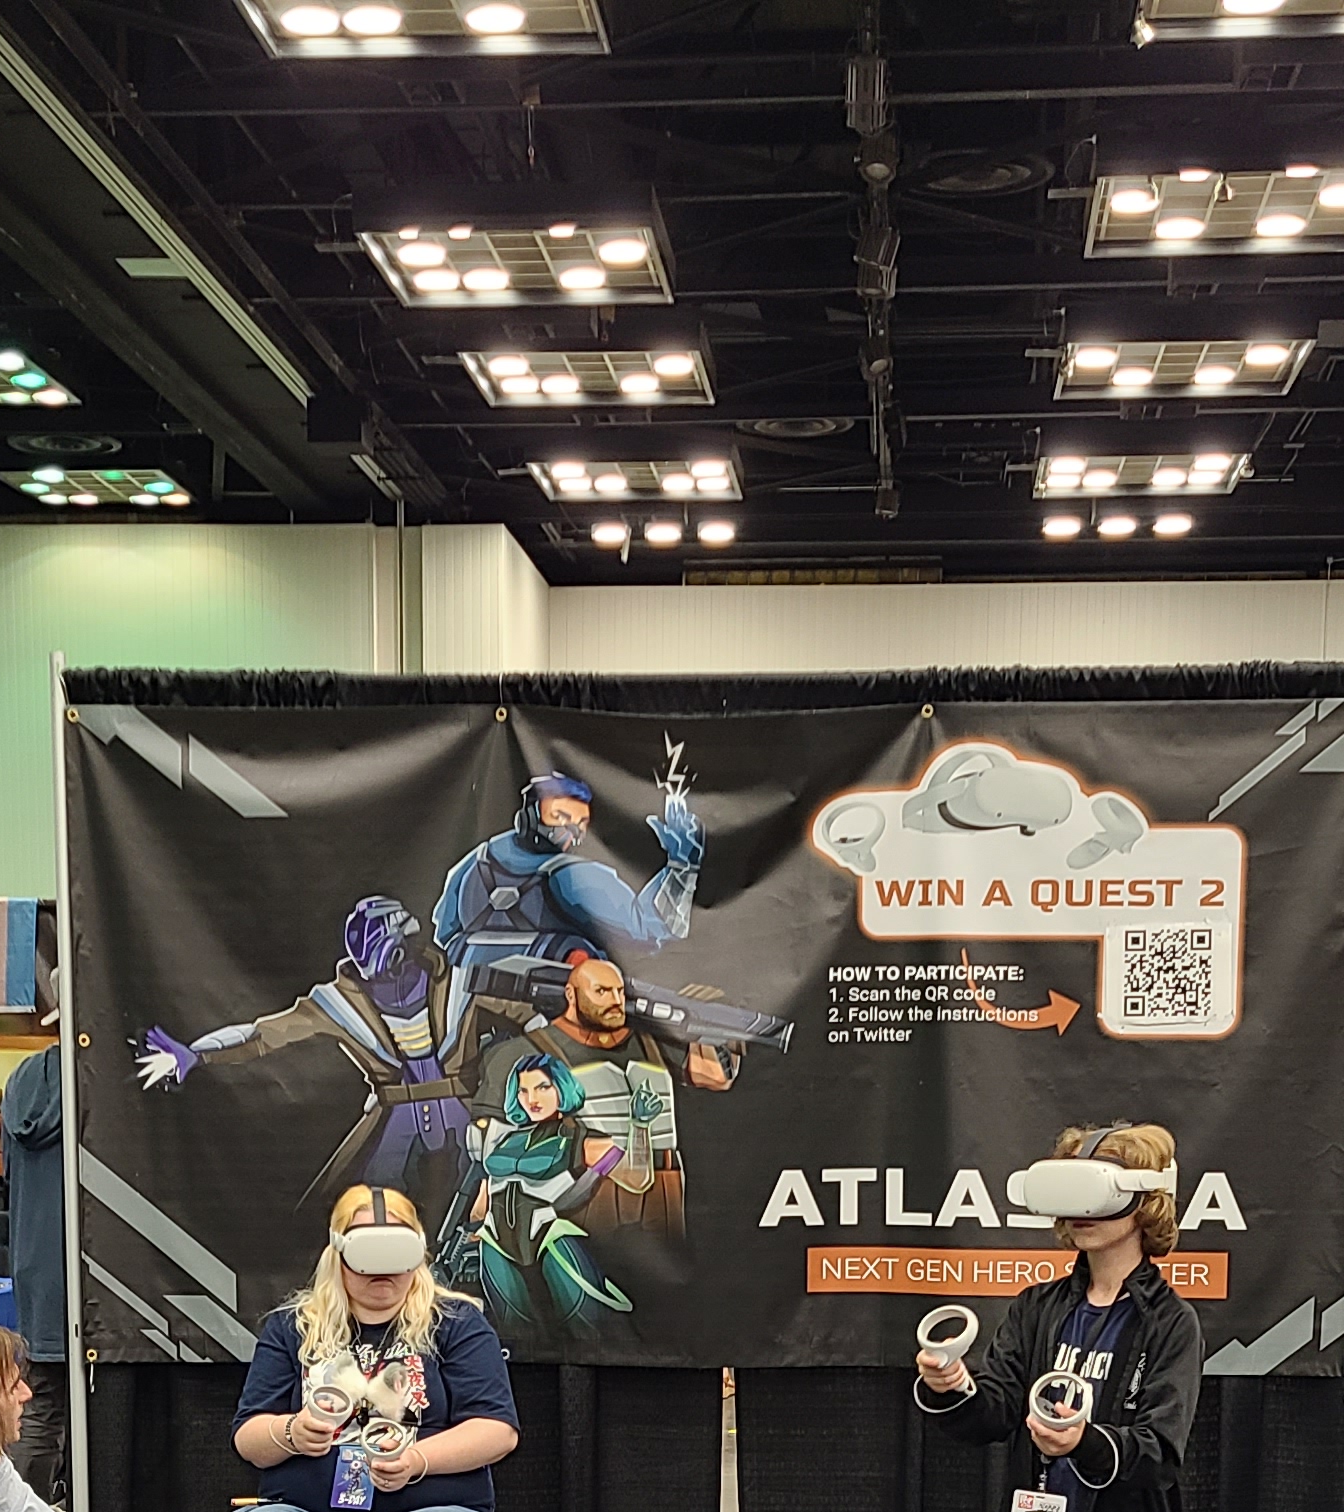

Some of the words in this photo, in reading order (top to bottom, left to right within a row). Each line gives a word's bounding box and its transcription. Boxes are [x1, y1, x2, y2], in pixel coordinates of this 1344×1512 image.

[875, 879, 964, 907] WIN
[982, 879, 1013, 907] A
[1030, 878, 1184, 913] QUEST
[1199, 879, 1226, 907] 2
[828, 965, 872, 983] HOW
[875, 965, 900, 982] TO
[904, 964, 1026, 982] PARTICIPATE:
[828, 986, 845, 1003] 1.
[848, 986, 891, 1002] Scan
[894, 986, 921, 1002] the
[924, 986, 950, 1003] QR
[952, 985, 996, 1002] code
[828, 1006, 845, 1023] 2.
[848, 1006, 905, 1022] Follow
[907, 1006, 933, 1022] the
[936, 1005, 1039, 1022] instructions
[828, 1029, 850, 1043] on
[853, 1026, 913, 1043] Twitter
[821, 1257, 899, 1281] NEXT
[907, 1258, 962, 1283] GEN
[973, 1259, 1054, 1285] HERO
